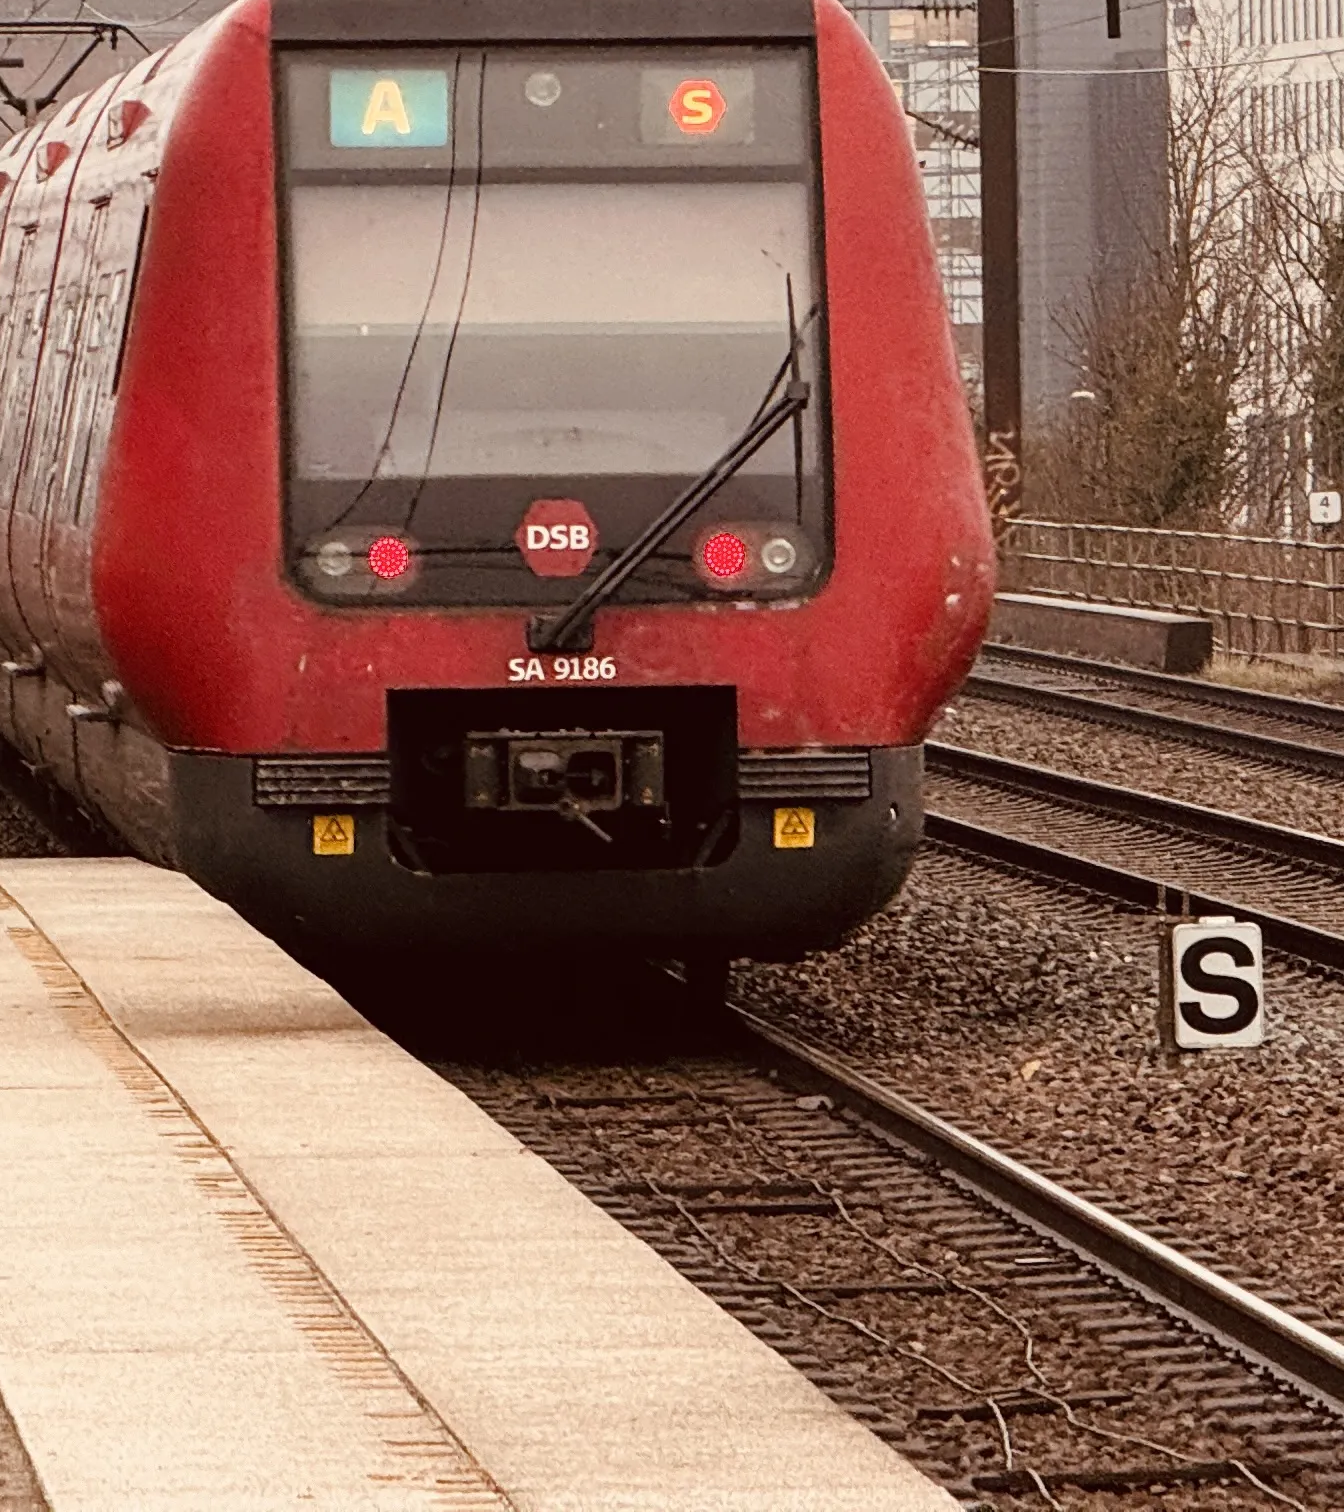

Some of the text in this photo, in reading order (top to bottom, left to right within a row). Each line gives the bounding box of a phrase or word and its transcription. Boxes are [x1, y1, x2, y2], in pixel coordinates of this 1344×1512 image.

[361, 80, 411, 135] A
[681, 89, 714, 125] S
[1319, 495, 1331, 508] 4
[526, 524, 590, 550] DSB
[508, 656, 617, 681] SA 9186
[1178, 936, 1259, 1035] S
